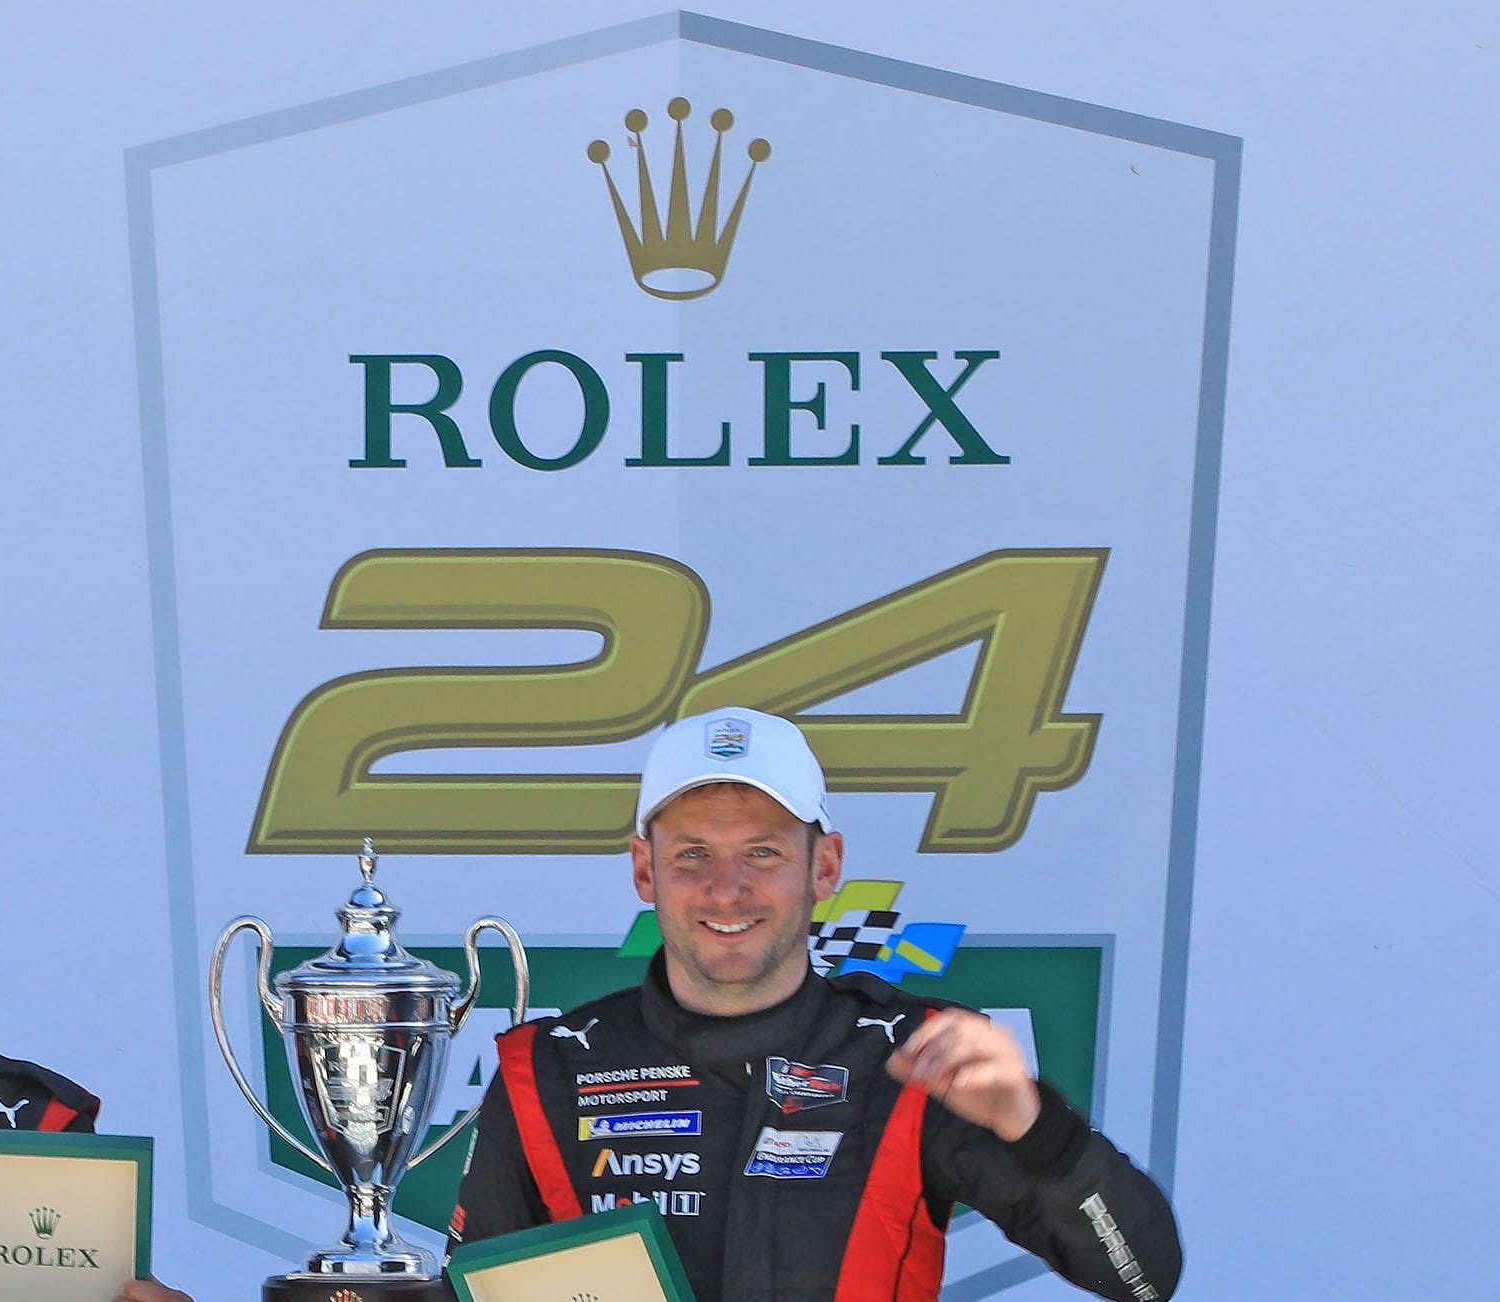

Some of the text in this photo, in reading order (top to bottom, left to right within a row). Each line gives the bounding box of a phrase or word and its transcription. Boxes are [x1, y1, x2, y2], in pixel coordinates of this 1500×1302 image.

[347, 349, 1012, 472] ROLEX
[245, 546, 1112, 855] 24
[576, 1064, 692, 1086] PORSCHE PENSKE
[577, 1088, 669, 1108] MOTORSPORT
[591, 1148, 701, 1181] Ansys
